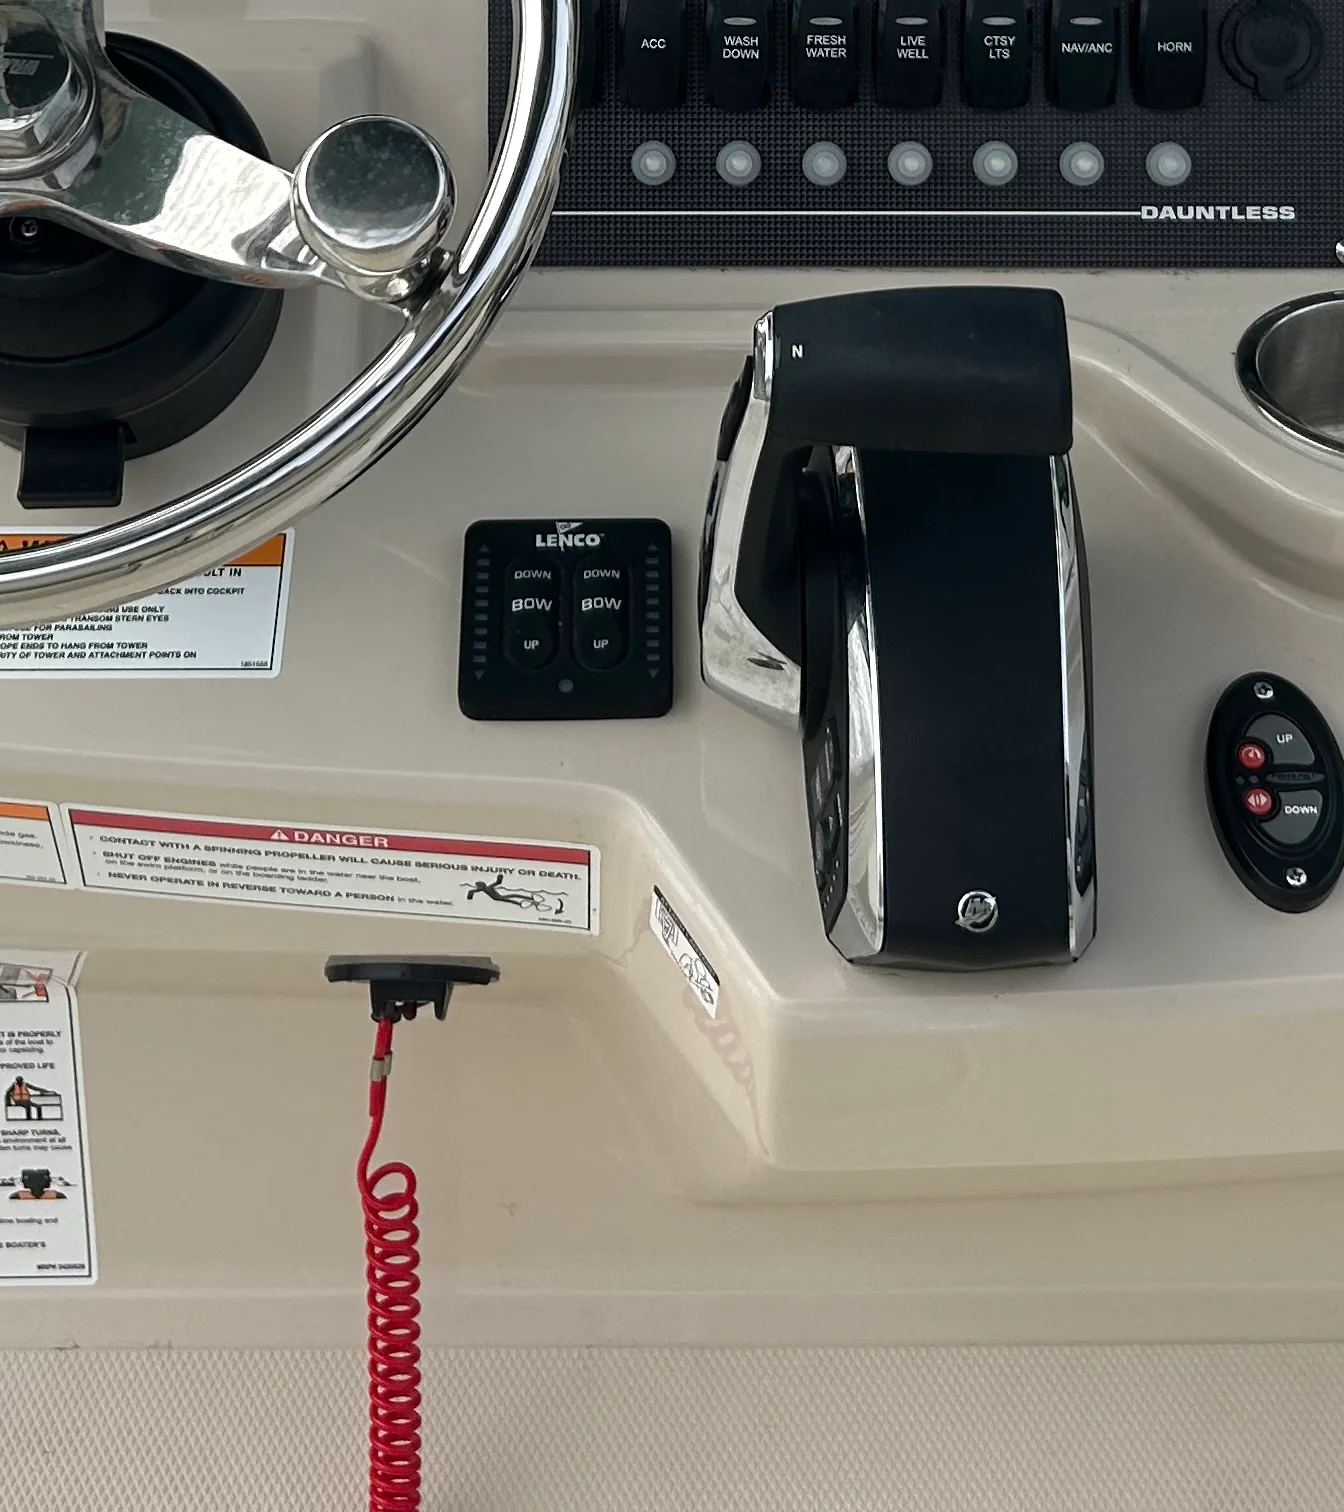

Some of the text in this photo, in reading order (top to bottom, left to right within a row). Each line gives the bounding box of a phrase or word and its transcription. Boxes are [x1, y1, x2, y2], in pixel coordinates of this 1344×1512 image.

[640, 38, 667, 49] ACC
[724, 35, 759, 47] WASH
[806, 35, 846, 46] FRESH
[900, 35, 926, 46] LIVE
[984, 35, 1016, 47] CTSY
[1157, 40, 1193, 52] HORN
[722, 48, 759, 59] DOWN
[806, 47, 847, 58] WATER
[897, 48, 929, 59] WELL
[989, 48, 1010, 59] LTS
[1061, 42, 1113, 54] NAV/ANC
[1141, 206, 1296, 220] DAUNTLESS
[791, 345, 804, 357] N
[535, 533, 601, 550] LENCO
[514, 569, 552, 580] DOWN
[583, 569, 621, 579] DOWN
[184, 587, 204, 595] INTO
[206, 587, 244, 595] COCKPIT
[512, 597, 553, 612] BOW
[581, 596, 622, 611] BOW
[146, 614, 168, 622] EYES
[22, 633, 53, 641] TOWER
[20, 642, 44, 650] ENDS
[47, 642, 58, 650] TO
[60, 642, 86, 650] HANG
[88, 642, 113, 650] FROM
[116, 642, 147, 650] TOWER
[523, 640, 539, 650] UP
[593, 639, 609, 649] UP
[18, 651, 31, 659] OF
[34, 651, 65, 659] TOWER
[67, 651, 86, 659] AND
[88, 651, 146, 659] ATTACHMENT
[148, 651, 180, 659] POINTS
[183, 651, 196, 659] ON
[1276, 734, 1293, 743] UP
[1284, 805, 1318, 814] DOWN
[294, 831, 389, 848] DANGER
[99, 836, 155, 848] CONTACT
[158, 840, 189, 850] WITH
[193, 842, 200, 851] A
[264, 848, 335, 861] PROPELLER
[338, 853, 367, 863] WILL
[370, 856, 411, 867] CAUSE
[470, 863, 514, 874] INJURY
[518, 867, 535, 876] OR
[108, 870, 147, 881] NEVER
[150, 874, 204, 886] OPERATE
[207, 878, 219, 888] IN
[345, 890, 394, 902] PERSON
